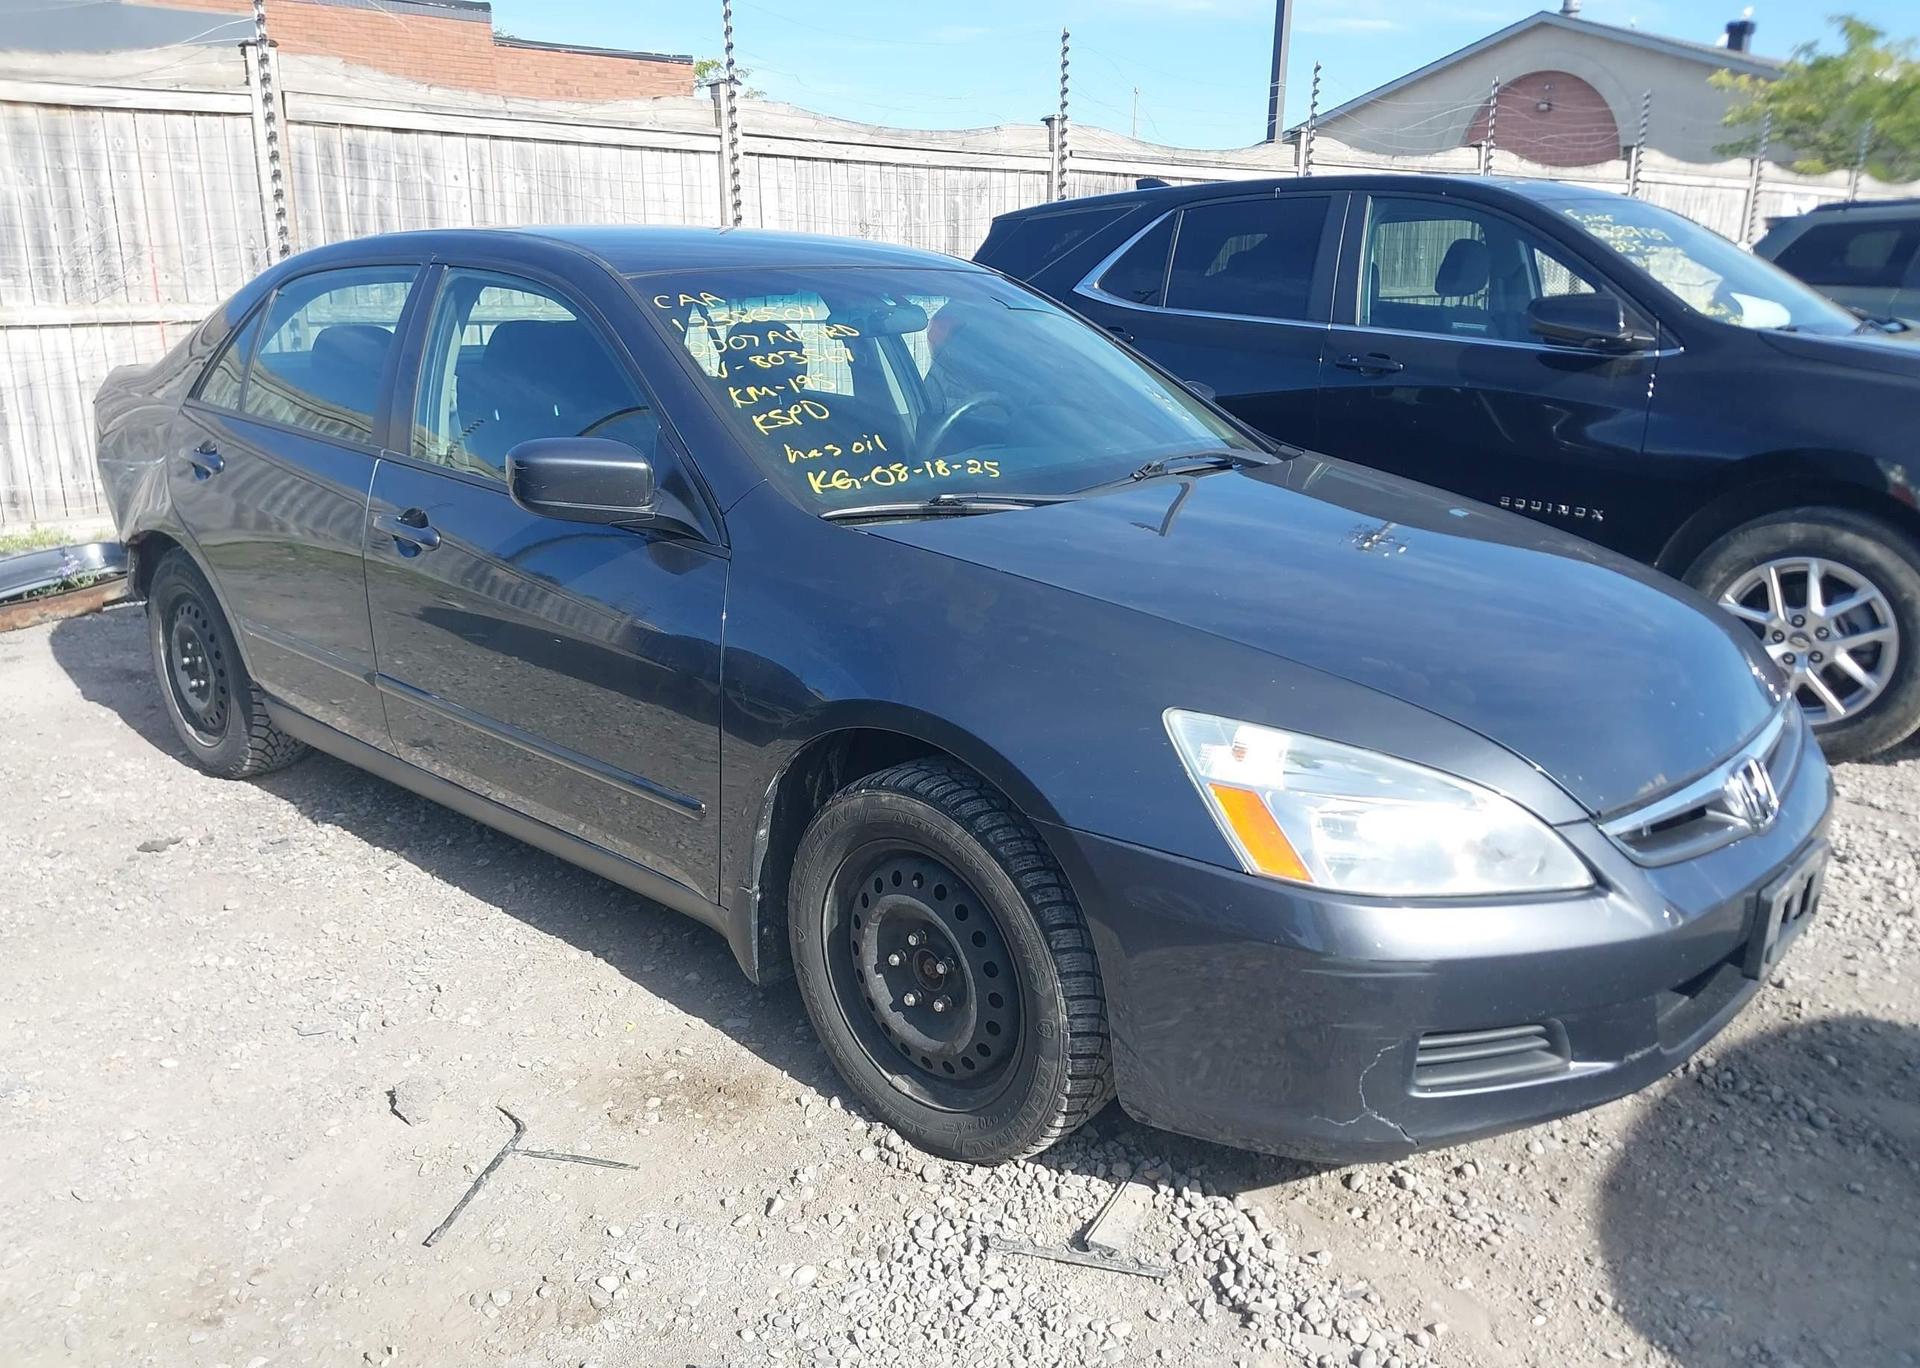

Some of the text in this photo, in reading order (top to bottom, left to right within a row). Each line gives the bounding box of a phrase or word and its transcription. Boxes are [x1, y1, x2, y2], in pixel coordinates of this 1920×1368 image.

[653, 291, 727, 310] CAA
[784, 434, 888, 464] has oil
[1499, 496, 1604, 521] EQUINOX
